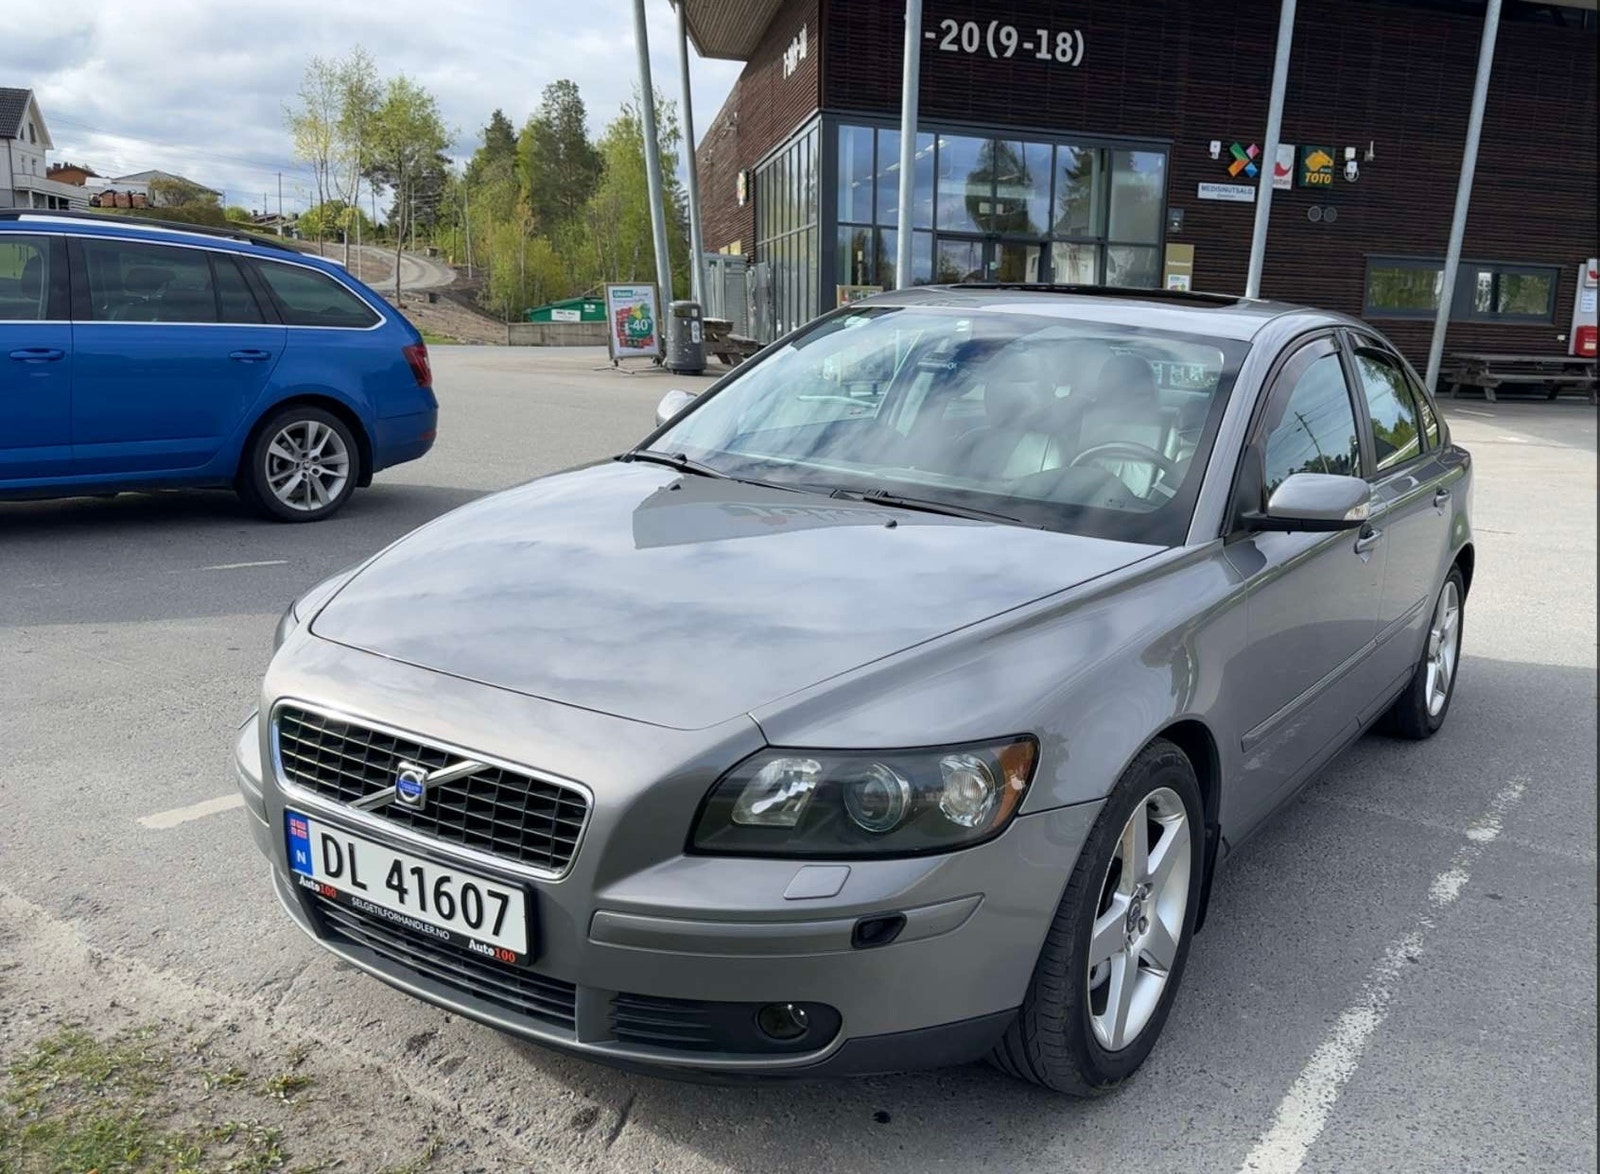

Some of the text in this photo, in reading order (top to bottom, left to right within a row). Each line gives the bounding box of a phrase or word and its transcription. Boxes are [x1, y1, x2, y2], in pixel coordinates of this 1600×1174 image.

[924, 19, 1084, 67] -20(9-18)
[1305, 172, 1332, 184] TOTO
[295, 849, 307, 865] N
[298, 875, 337, 898] Auto100
[321, 832, 510, 937] DL 41607
[352, 897, 450, 941] SELGETILFORHANDLER.NO
[468, 939, 517, 963] Auto100
